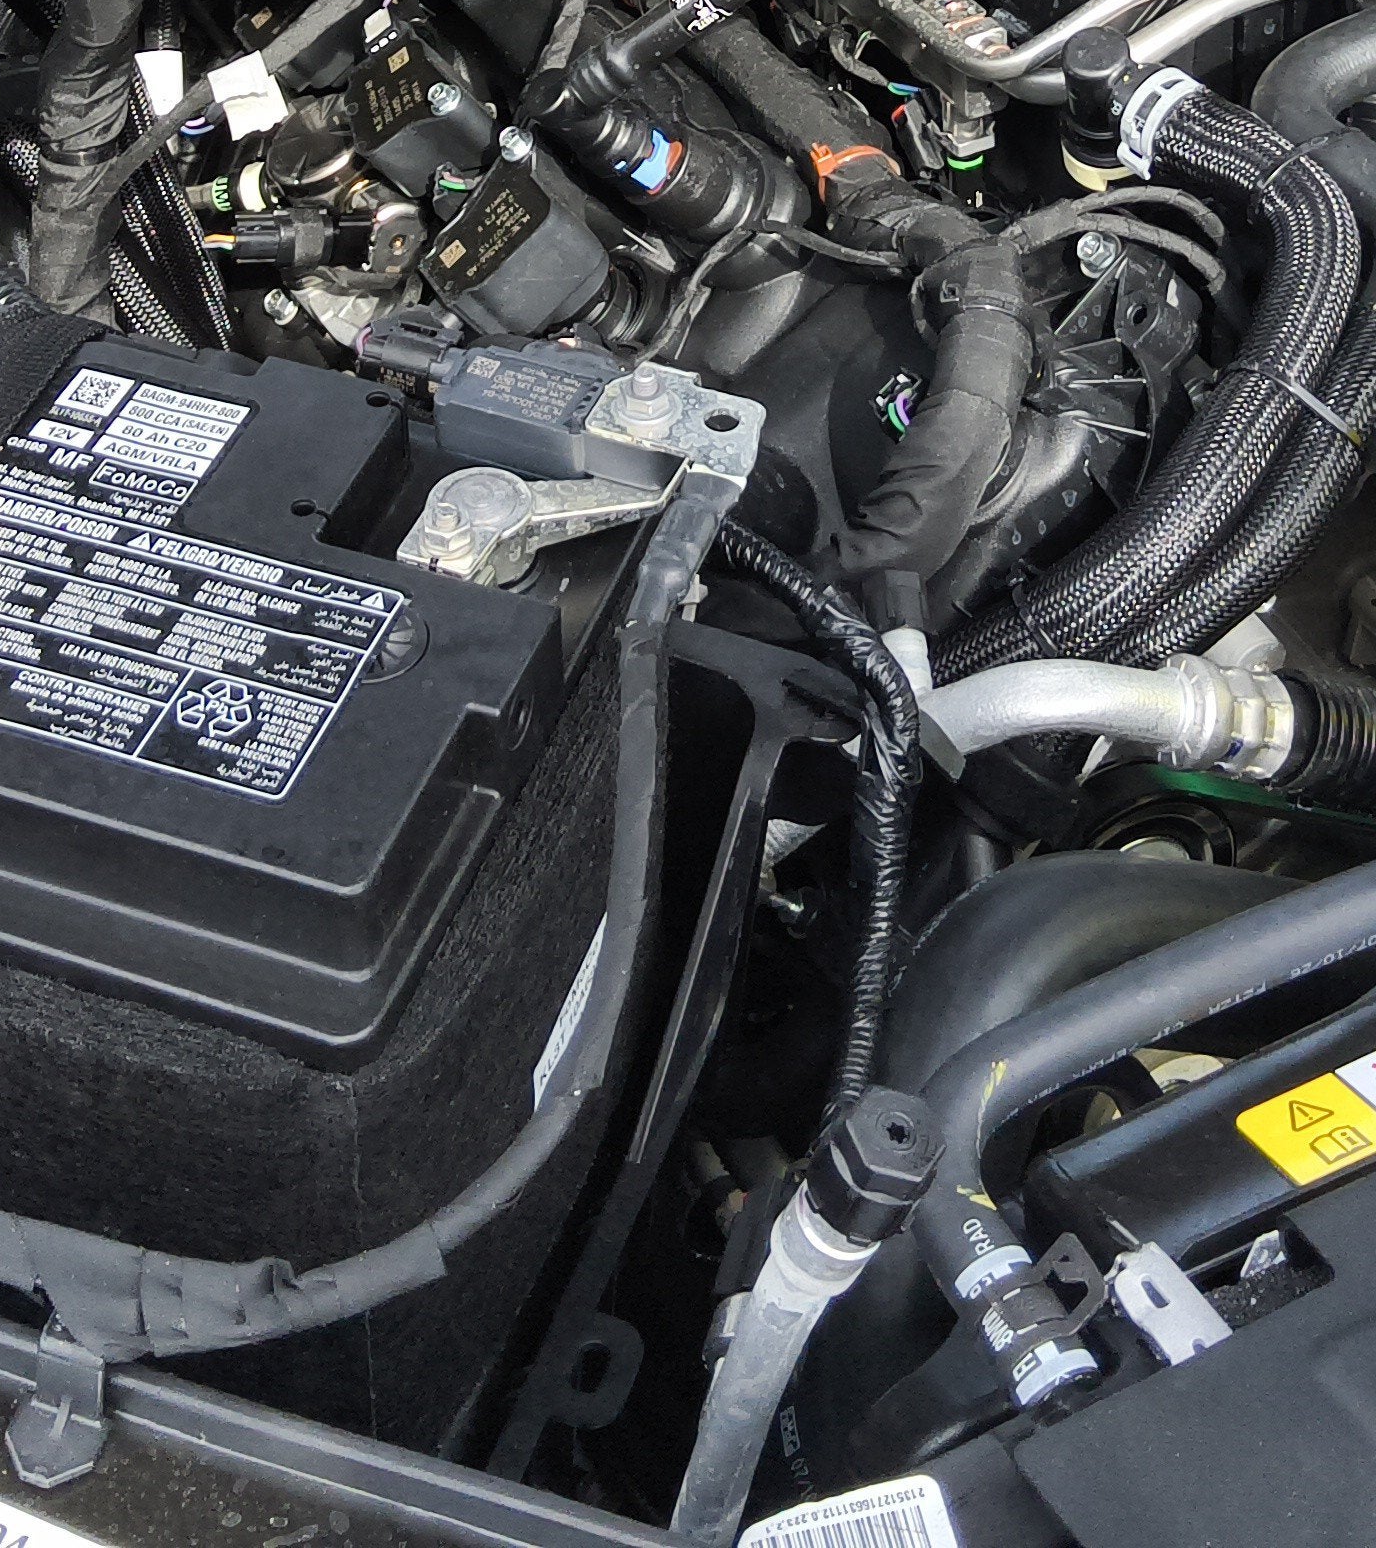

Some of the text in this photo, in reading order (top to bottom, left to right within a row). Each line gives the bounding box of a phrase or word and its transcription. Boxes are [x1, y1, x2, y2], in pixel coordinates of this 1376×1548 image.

[128, 405, 229, 435] 800 CCA (SAE/EN)
[48, 426, 79, 440] 12V
[121, 425, 206, 451] 80 Ah C20
[49, 448, 93, 469] MF
[104, 442, 196, 470] AGM/VRLA
[0, 475, 30, 490] Motor
[29, 483, 74, 504] Company,
[93, 463, 190, 502] FoMoCo
[12, 530, 37, 546] OUT
[31, 535, 50, 549] OF
[45, 538, 69, 554] THE
[11, 543, 29, 556] OF
[24, 546, 77, 569] CHILDREN.
[90, 550, 122, 567] TENIR
[116, 557, 147, 574] HORS
[154, 567, 174, 581] LA
[152, 538, 282, 582] PELIGRO/VENENO
[0, 564, 28, 580] EYES
[116, 570, 140, 585] DES
[135, 574, 184, 596] ENFANTS.
[92, 588, 114, 602] LES
[108, 592, 136, 608] YEUX
[191, 589, 211, 603] DE
[205, 593, 229, 608] LOS
[238, 588, 262, 604] DEL
[255, 593, 303, 615] ALCANCE
[46, 600, 97, 623] CONSULTER
[222, 622, 245, 637] LOS
[239, 627, 268, 643] OJOS
[155, 642, 179, 658] CON
[174, 647, 191, 661] EL
[189, 639, 225, 657] ACUDA
[244, 641, 269, 657] CON
[57, 642, 184, 685] LEA LAS INSTRUCCIONES.
[15, 669, 153, 714] CONTRA DERRAMES
[48, 689, 68, 703] de
[62, 694, 105, 714] plomo
[99, 705, 112, 717] y
[255, 689, 326, 716] BATTERY MUST
[202, 697, 232, 716] Pb
[254, 711, 270, 722] LA
[271, 704, 321, 724] RECYCLED
[242, 738, 259, 750] LA
[961, 1217, 994, 1255] RAD
